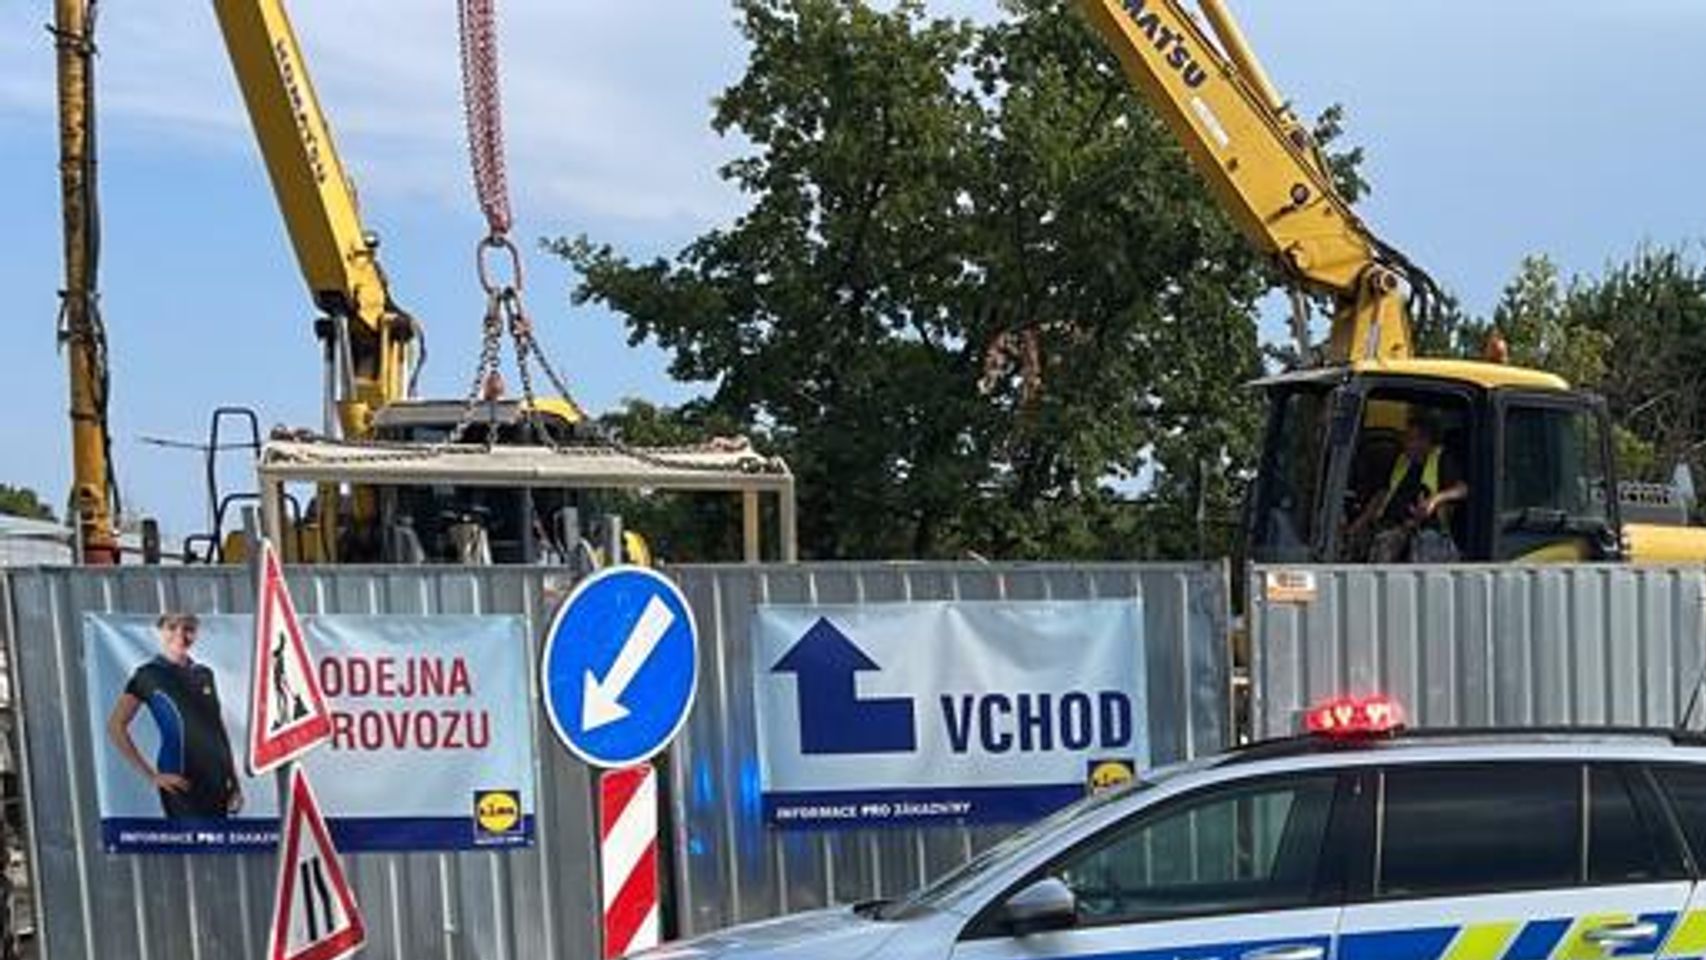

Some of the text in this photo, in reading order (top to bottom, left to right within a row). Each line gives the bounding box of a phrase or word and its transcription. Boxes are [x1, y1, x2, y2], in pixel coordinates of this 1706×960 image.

[320, 656, 472, 697] ODEJNA
[332, 710, 489, 751] ROVOZU
[940, 690, 1132, 754] VCHOD
[861, 803, 892, 817] PRO
